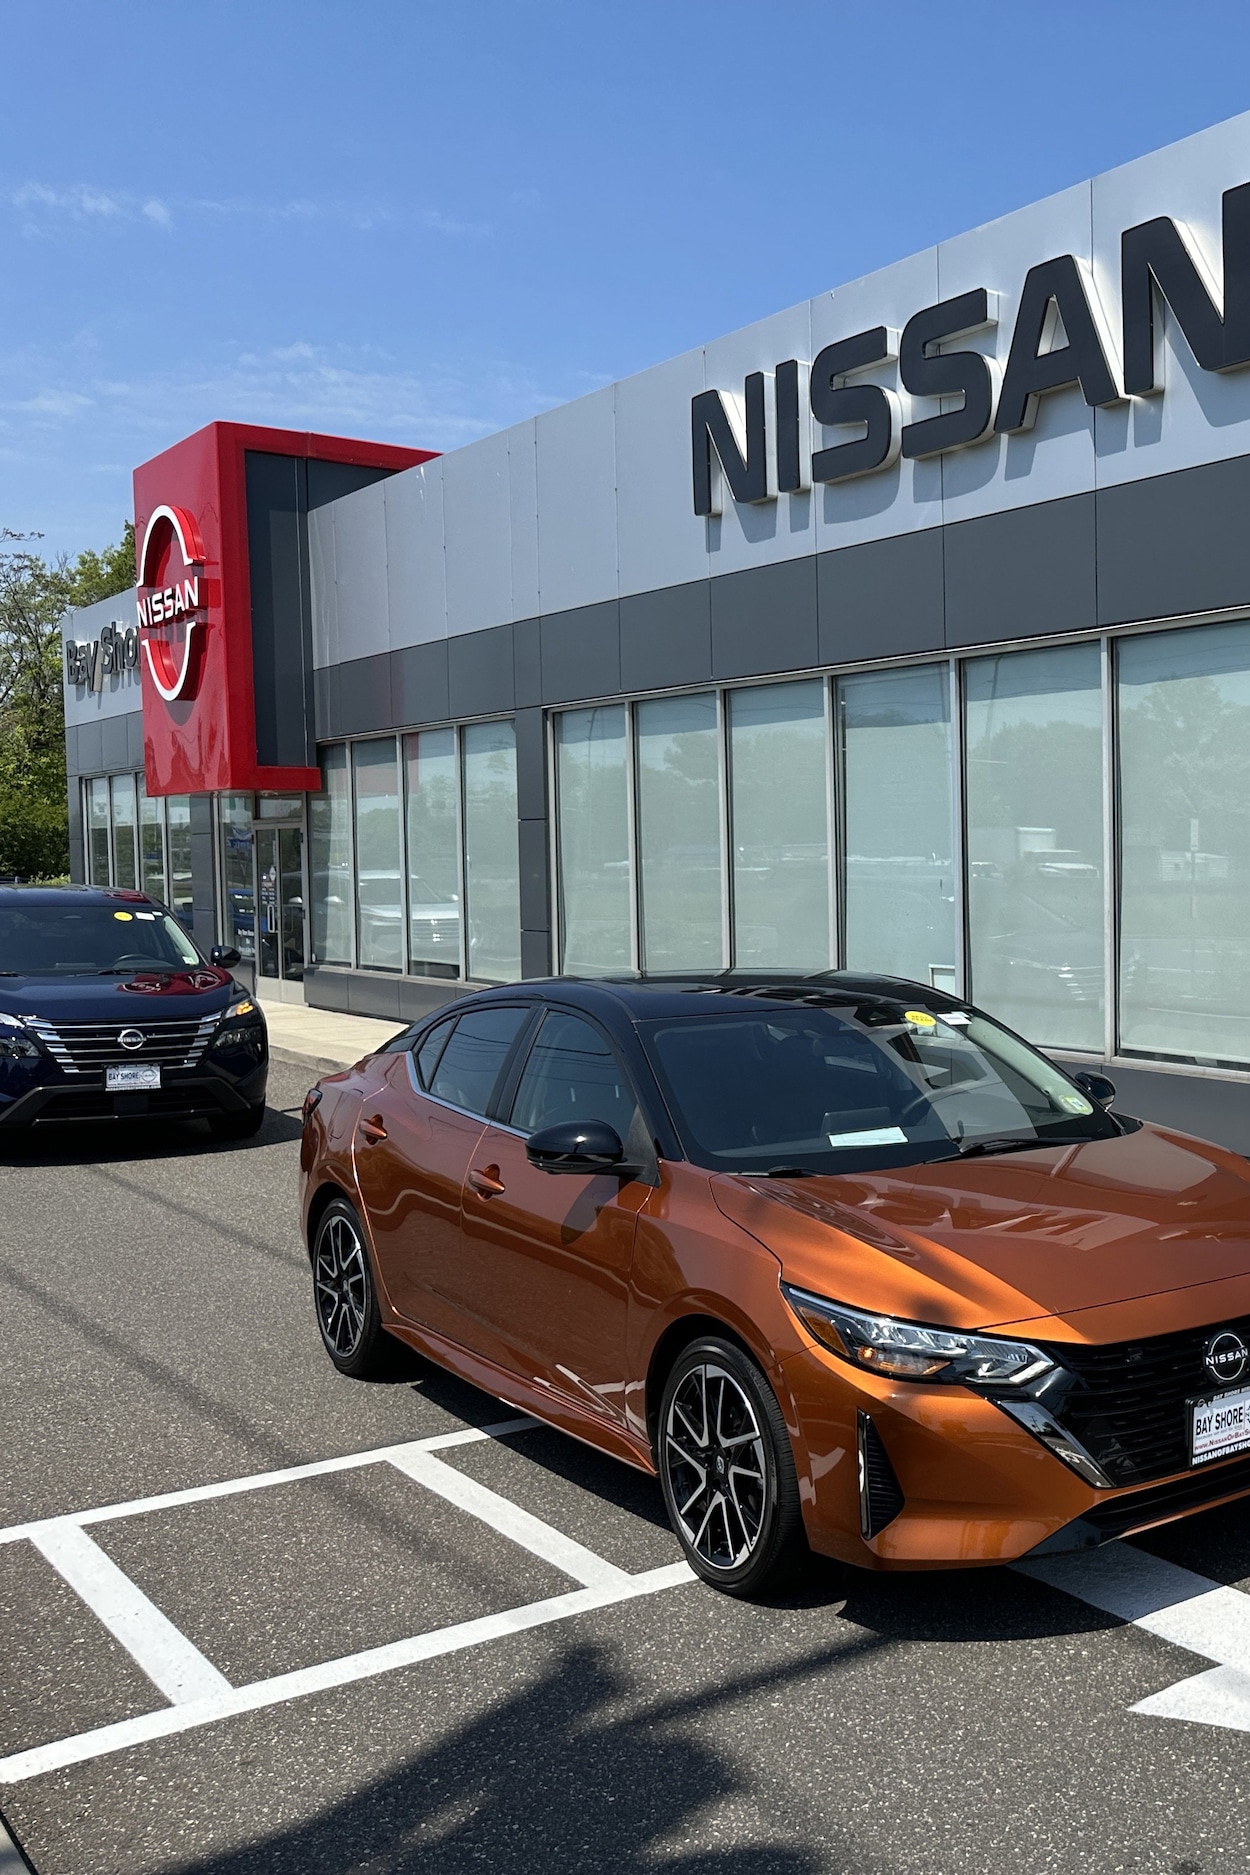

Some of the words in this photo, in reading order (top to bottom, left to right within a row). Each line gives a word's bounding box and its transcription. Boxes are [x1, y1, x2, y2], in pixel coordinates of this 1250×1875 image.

[136, 576, 199, 628] NISSAN
[66, 639, 102, 692] Bay
[108, 1072, 120, 1081] BAY
[120, 1071, 140, 1080] SHORE
[1206, 1348, 1248, 1366] NISSAN
[1195, 1414, 1214, 1436] BAY
[1215, 1406, 1244, 1430] SHORE
